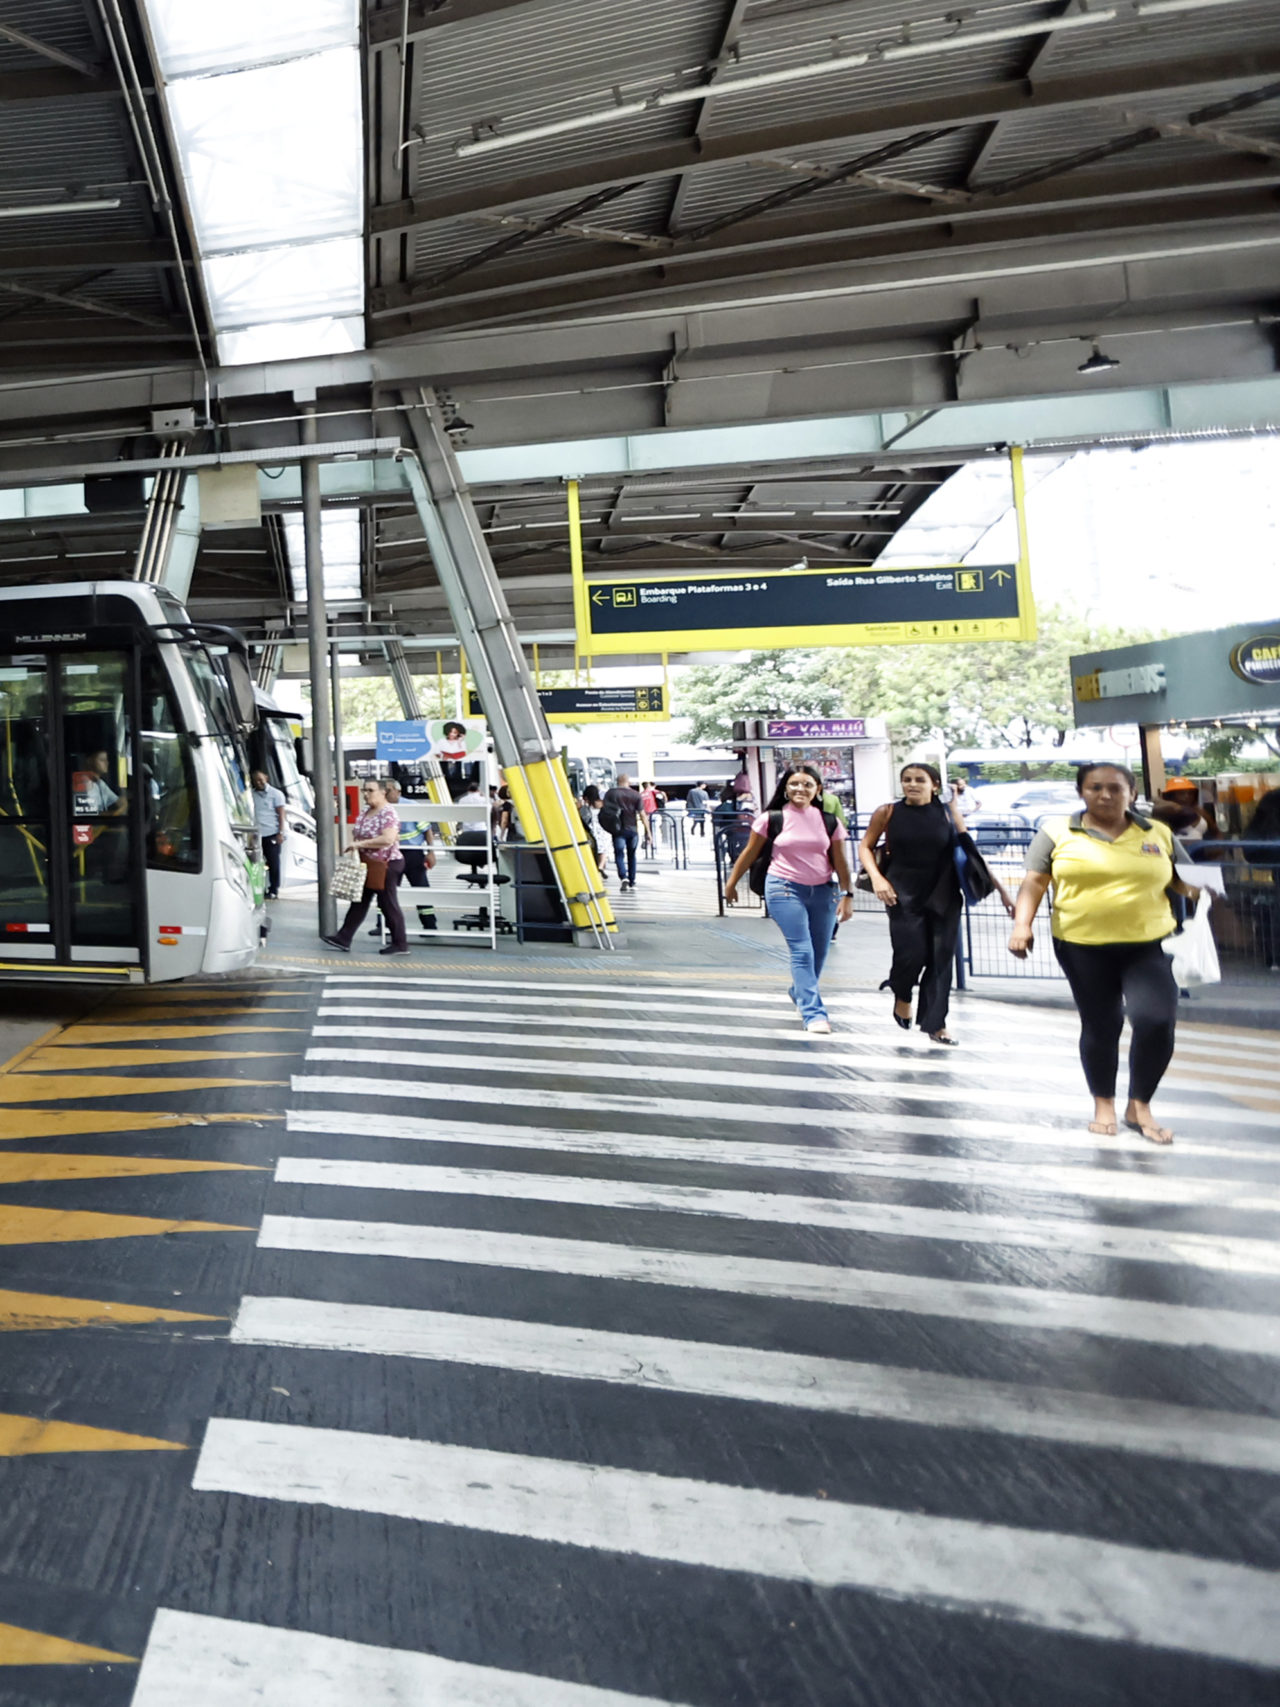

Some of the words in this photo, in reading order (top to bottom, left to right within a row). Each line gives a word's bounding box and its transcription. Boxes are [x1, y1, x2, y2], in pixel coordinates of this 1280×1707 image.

[825, 577, 853, 587] Saída
[855, 576, 875, 586] Rua
[876, 574, 917, 585] Gilberto
[918, 572, 953, 583] Sabino
[935, 581, 953, 590] Exit
[639, 587, 687, 598] Embarque
[688, 583, 743, 594] Plataformas
[745, 583, 751, 591] 3
[760, 582, 767, 591] 4
[640, 594, 677, 604] Boarding
[1252, 645, 1280, 661] CAF
